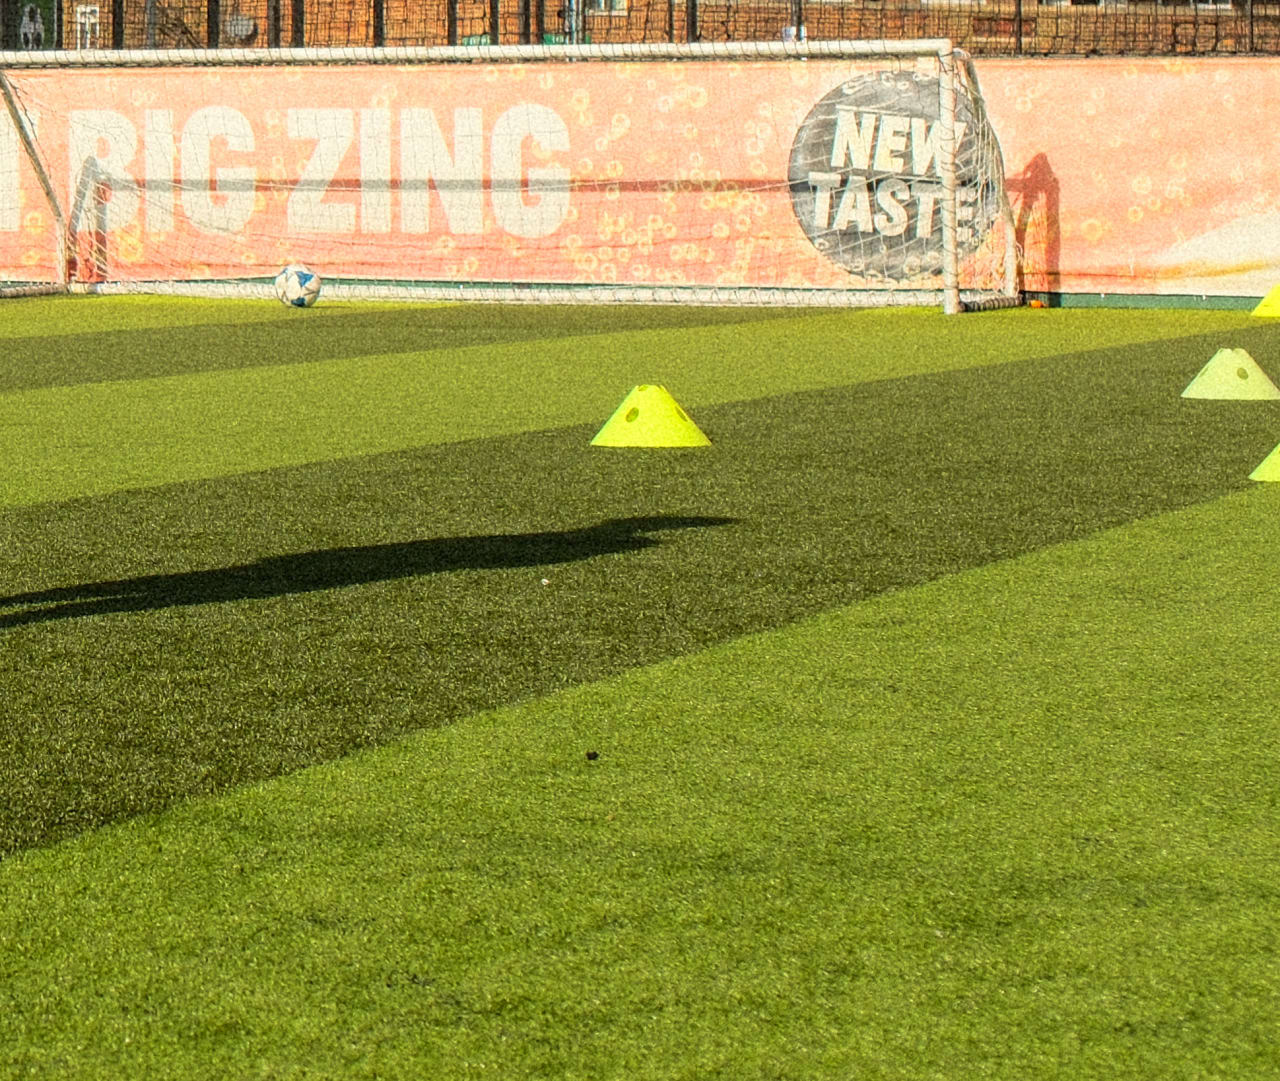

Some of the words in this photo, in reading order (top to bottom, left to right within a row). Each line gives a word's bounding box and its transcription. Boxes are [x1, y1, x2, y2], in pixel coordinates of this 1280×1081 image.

[67, 104, 256, 236] BIG
[286, 103, 571, 238] ZING
[831, 110, 968, 178] NEW
